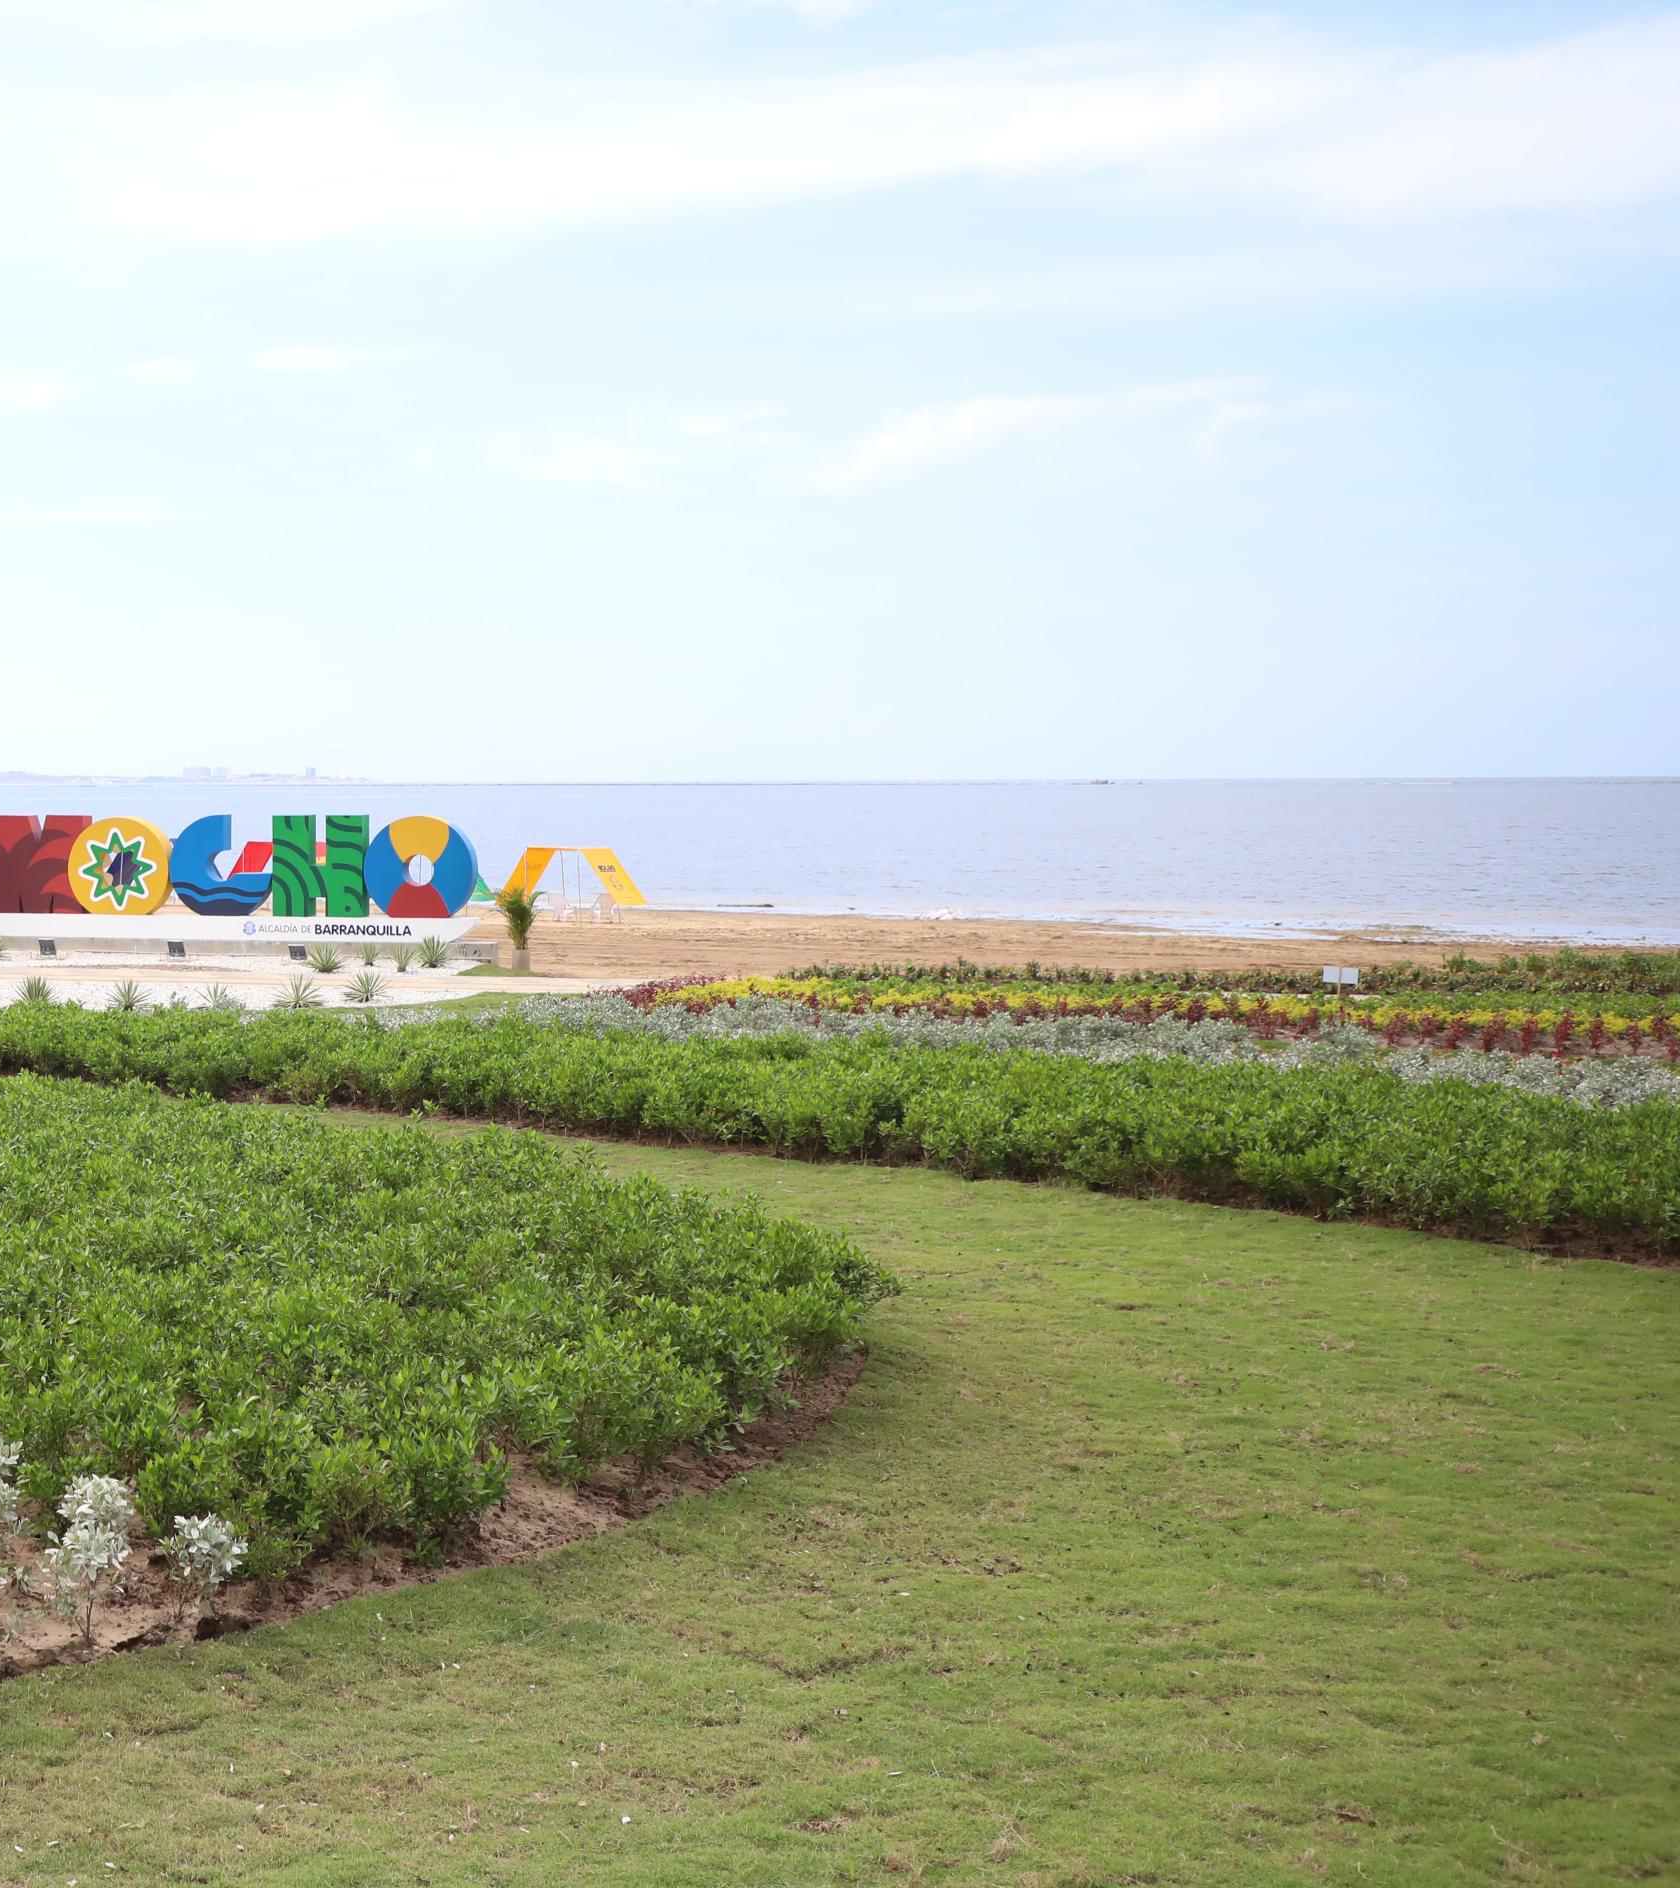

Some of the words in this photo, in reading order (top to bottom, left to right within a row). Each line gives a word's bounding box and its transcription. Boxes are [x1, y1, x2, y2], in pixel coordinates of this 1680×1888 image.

[258, 922, 298, 933] ALCALDÍA
[301, 925, 312, 934] DE
[314, 924, 412, 936] BARRANQUILLA
